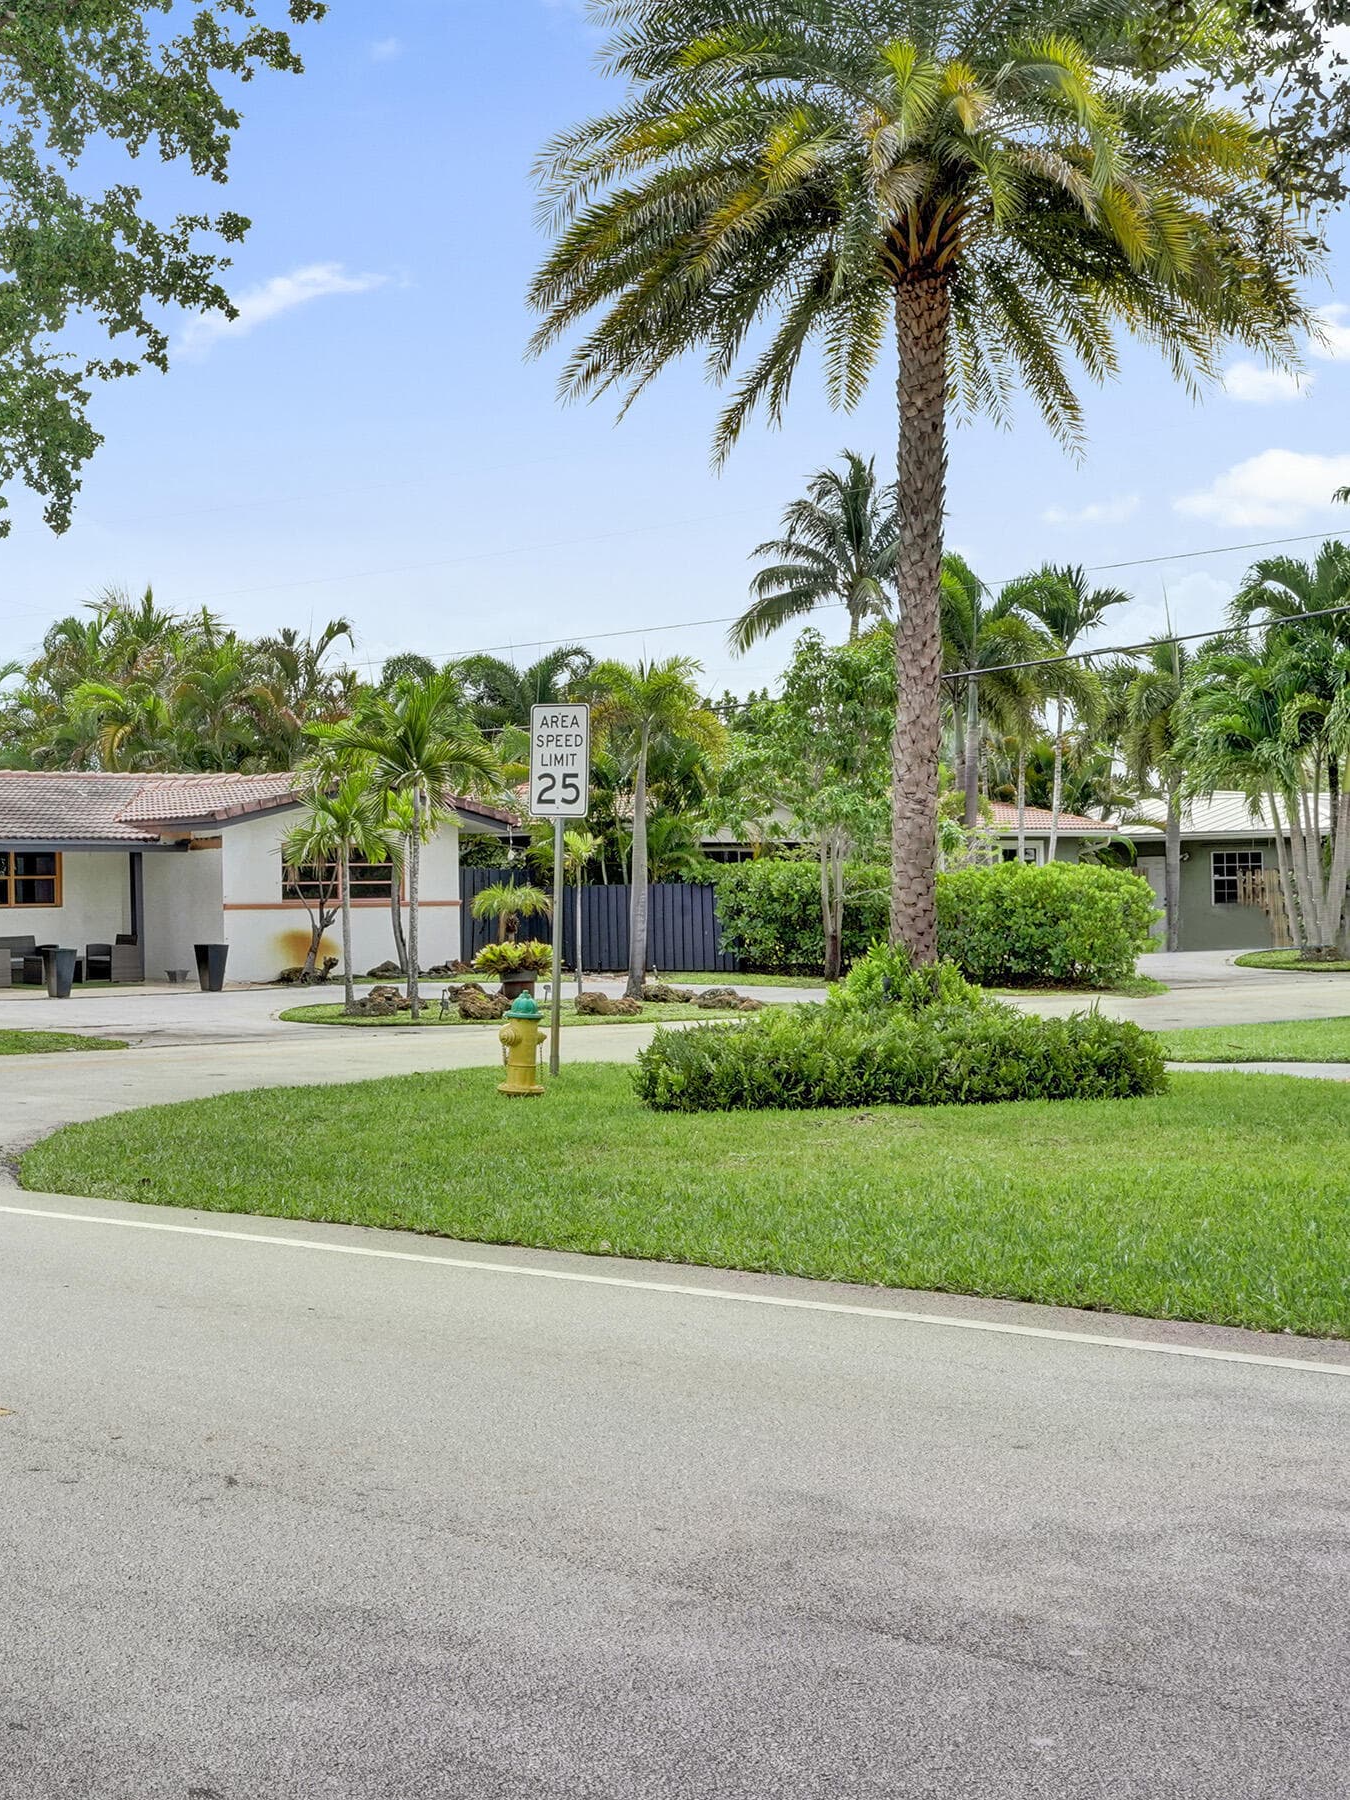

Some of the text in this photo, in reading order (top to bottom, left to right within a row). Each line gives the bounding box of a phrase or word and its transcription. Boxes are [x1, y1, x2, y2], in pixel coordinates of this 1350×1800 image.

[540, 715, 580, 729] AREA
[536, 734, 583, 748] SPEED
[541, 753, 577, 767] LIMIT
[536, 772, 580, 805] 25
